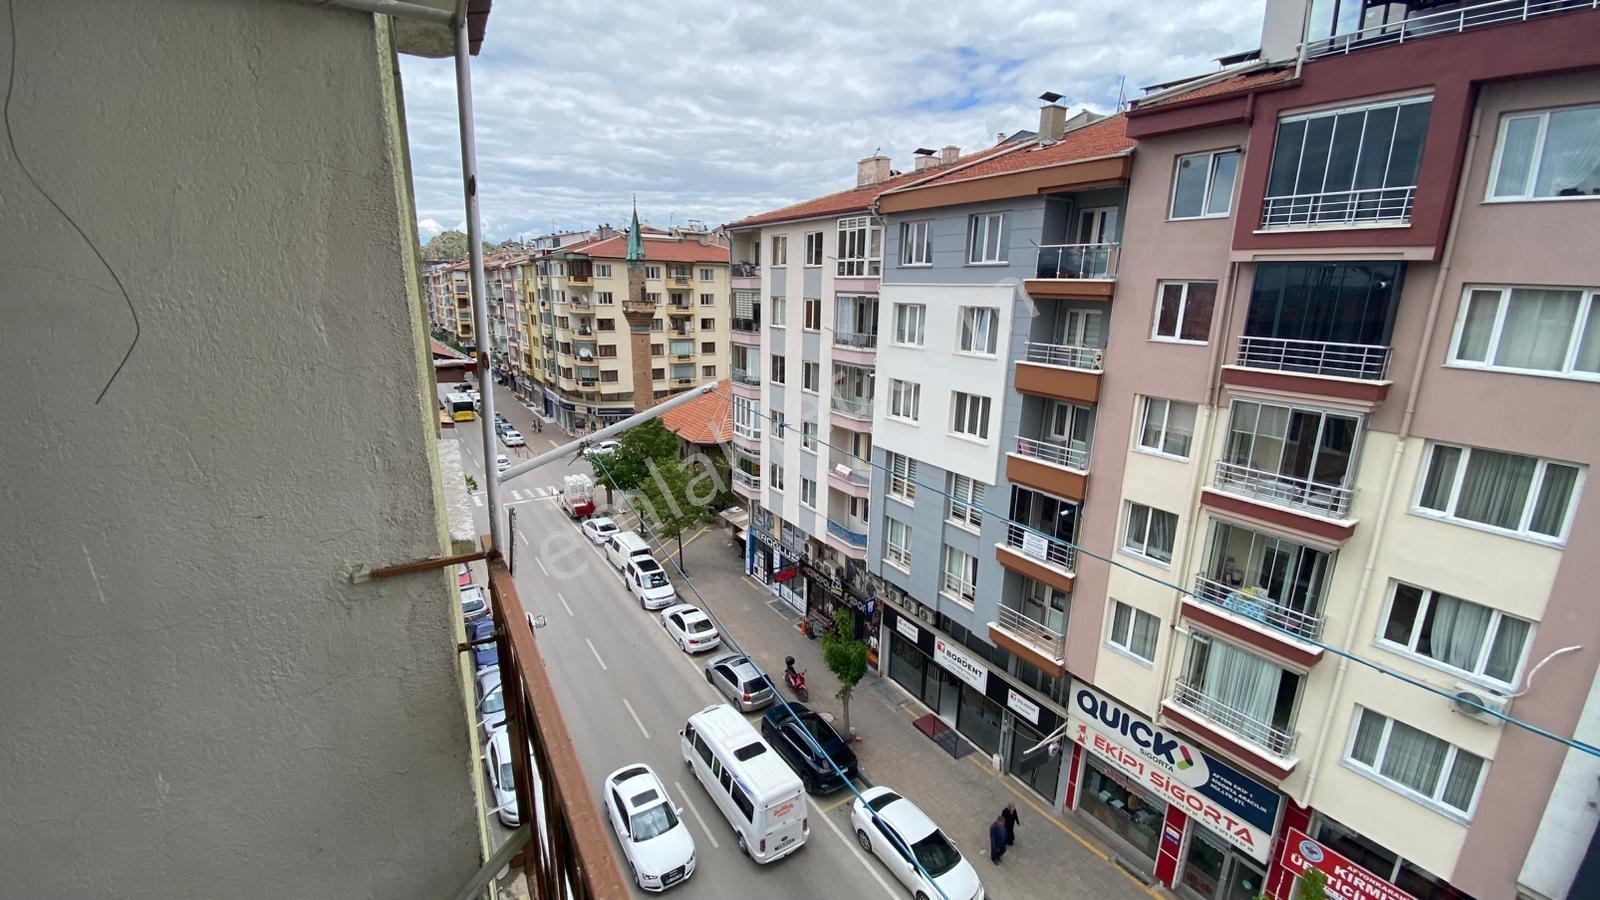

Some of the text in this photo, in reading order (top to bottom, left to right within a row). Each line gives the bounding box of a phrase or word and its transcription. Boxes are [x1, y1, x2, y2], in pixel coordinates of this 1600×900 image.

[946, 650, 983, 678] BORDENT
[1077, 690, 1179, 765] QUICK
[1149, 771, 1255, 847] SİGORTA
